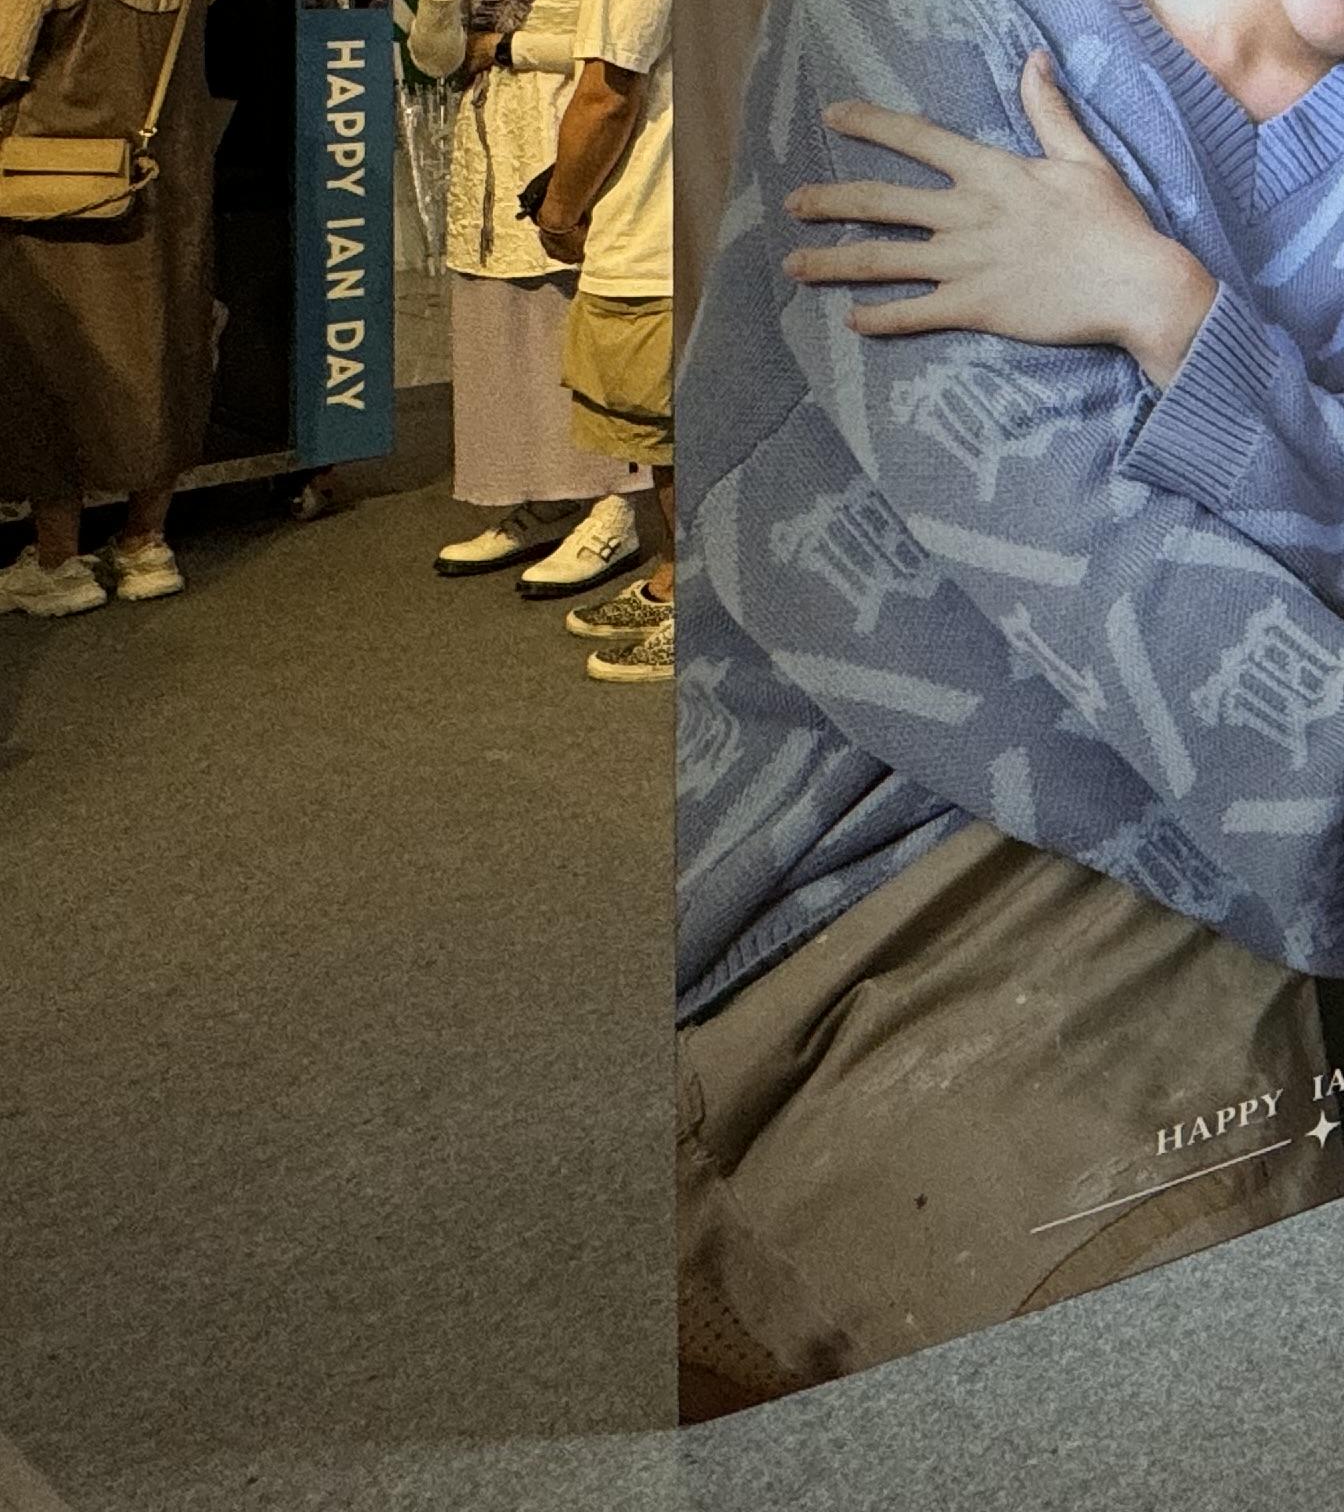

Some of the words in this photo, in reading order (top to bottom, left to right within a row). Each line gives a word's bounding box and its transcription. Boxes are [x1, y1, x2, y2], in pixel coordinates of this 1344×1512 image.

[327, 40, 366, 197] HAPPY
[326, 218, 366, 300] IAN
[326, 320, 366, 410] DAY
[1155, 1088, 1284, 1156] HAPPY
